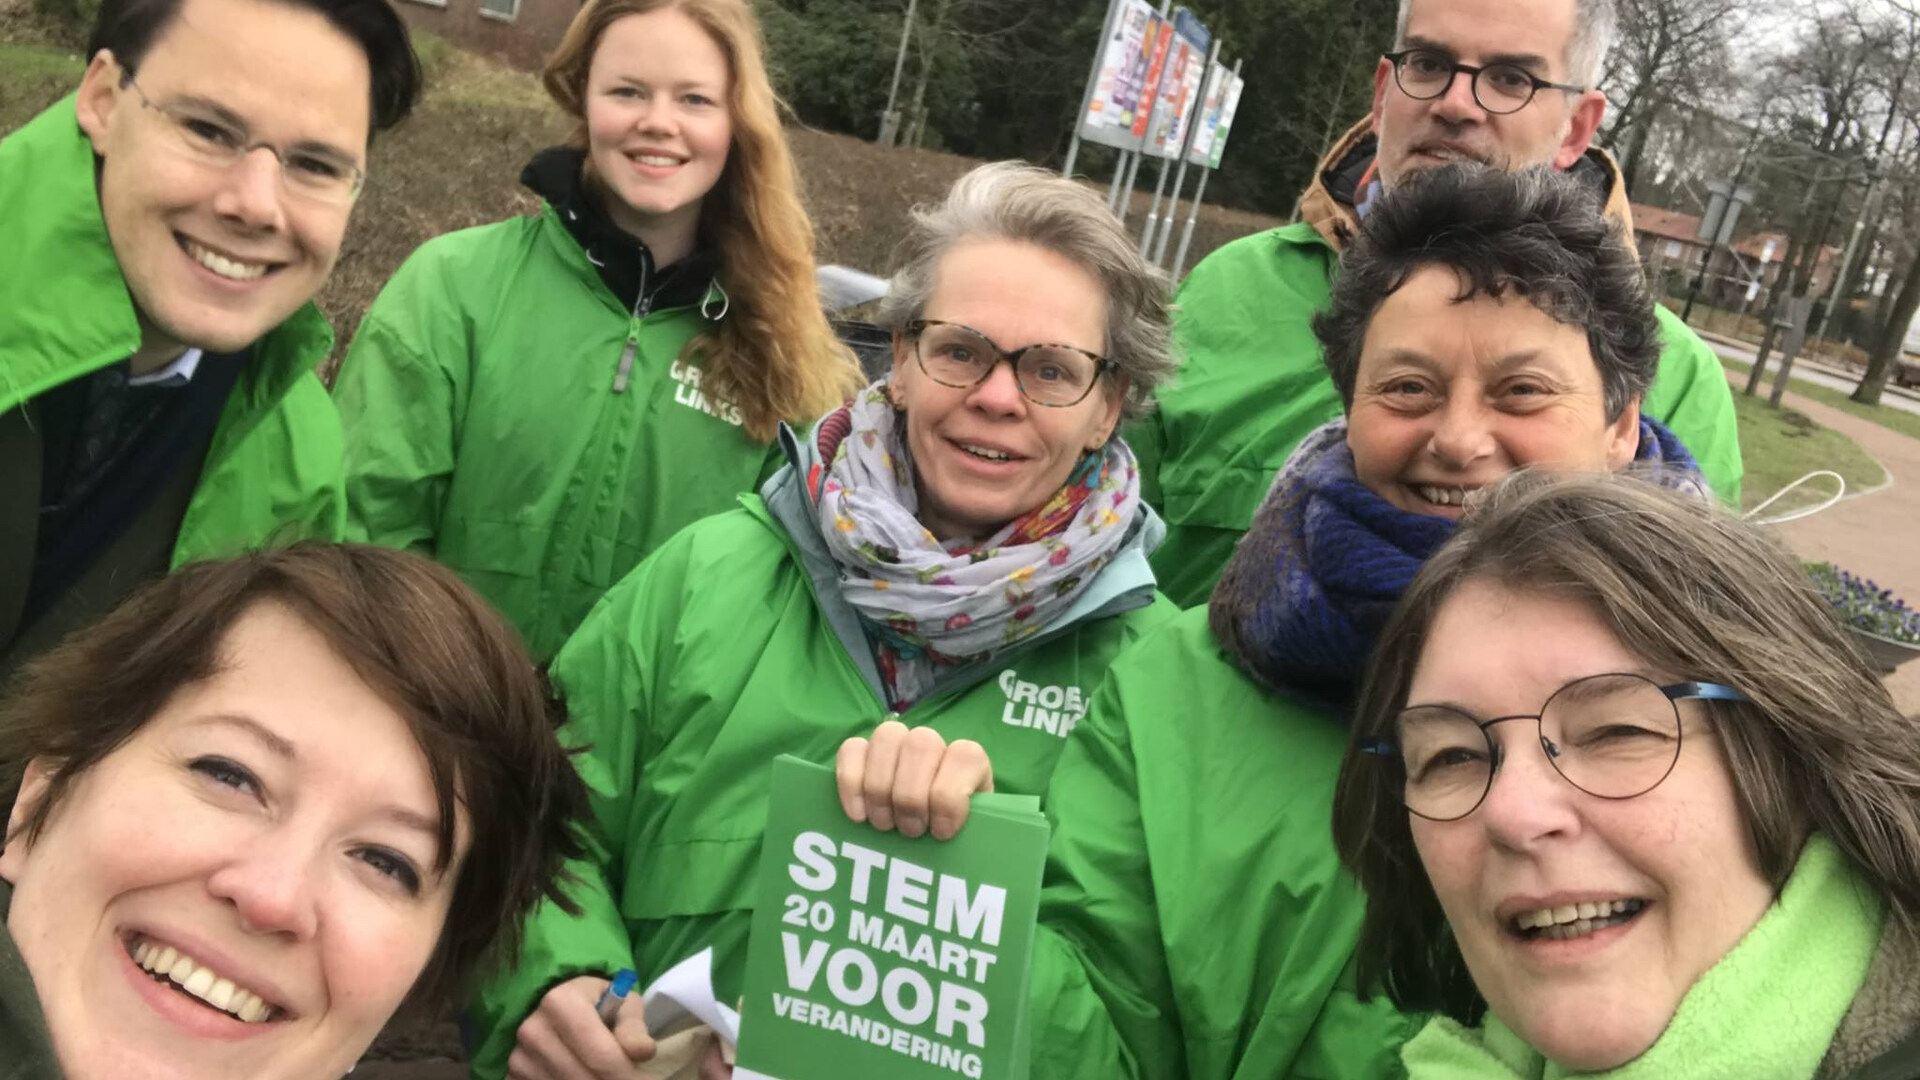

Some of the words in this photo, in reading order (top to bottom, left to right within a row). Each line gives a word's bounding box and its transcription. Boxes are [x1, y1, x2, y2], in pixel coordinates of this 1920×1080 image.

[998, 668, 1090, 717] GROE
[1001, 700, 1082, 738] LINK
[788, 831, 1007, 947] STEM
[782, 894, 835, 932] 20
[848, 909, 997, 983] MAART
[781, 931, 988, 1048] VOOR
[773, 993, 982, 1079] VERANDERING
